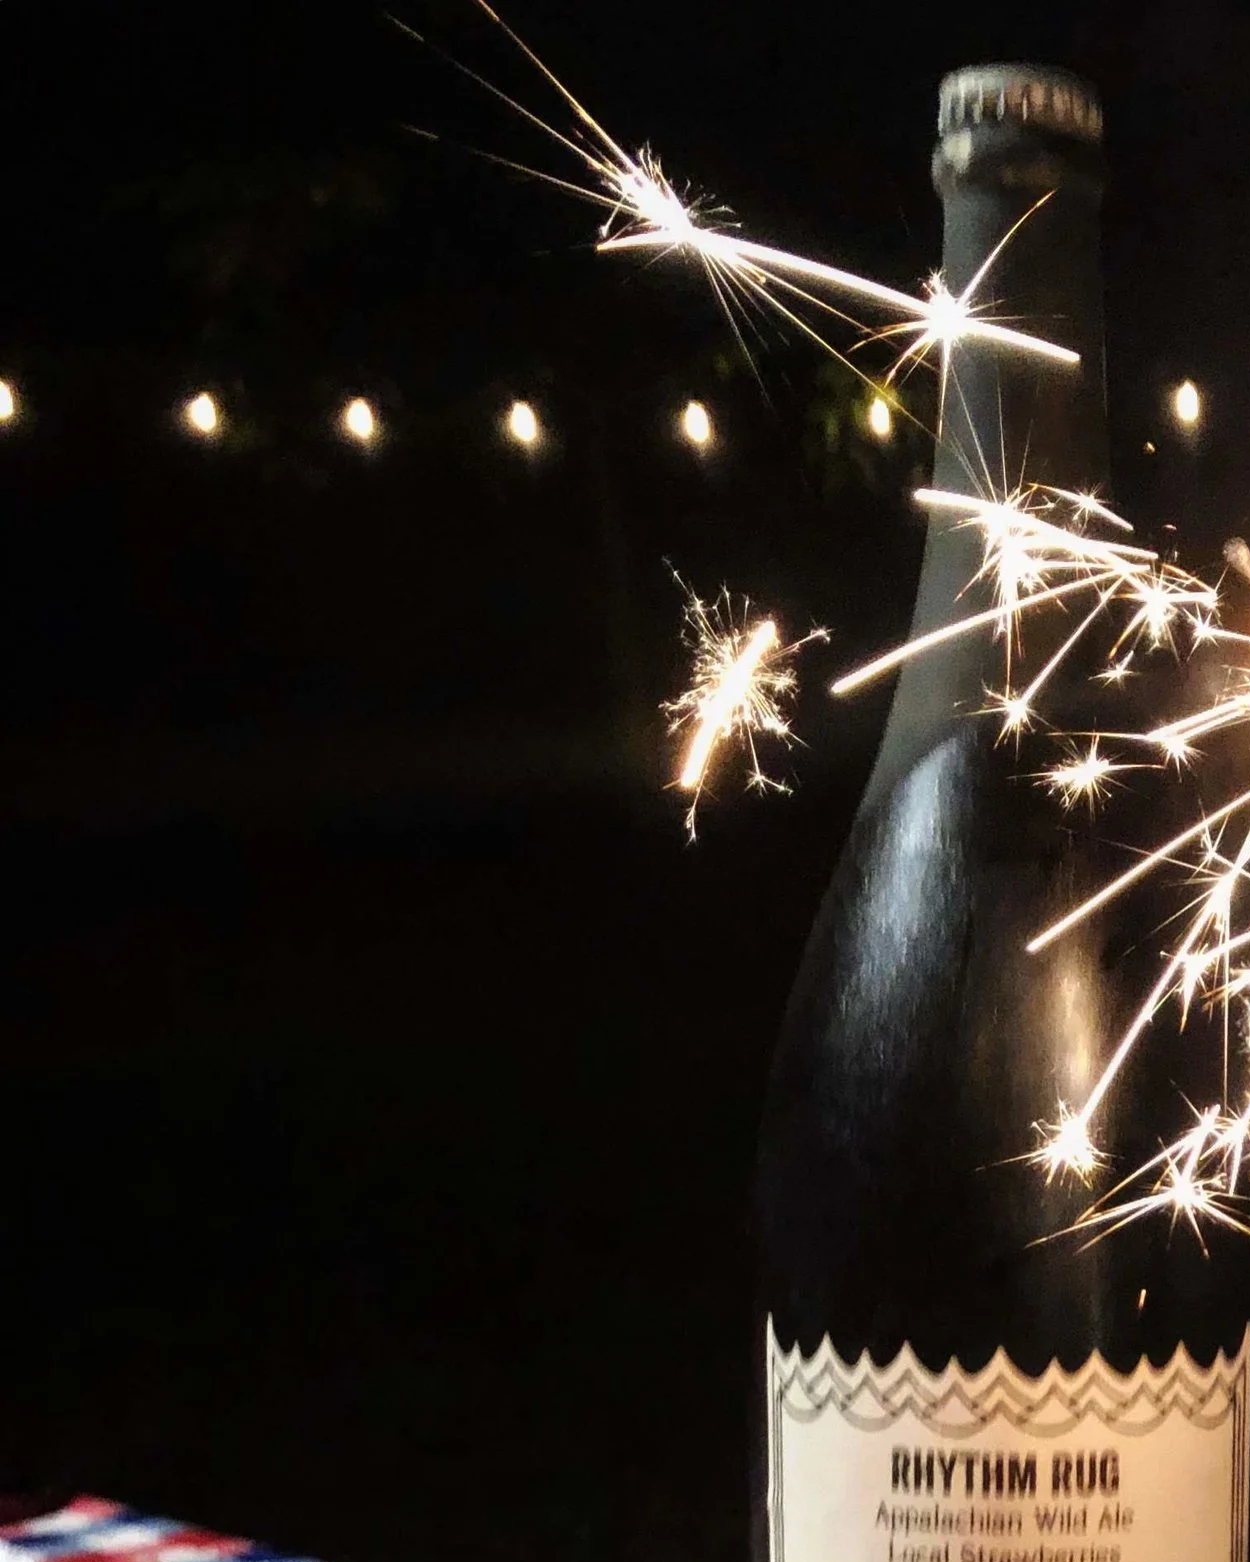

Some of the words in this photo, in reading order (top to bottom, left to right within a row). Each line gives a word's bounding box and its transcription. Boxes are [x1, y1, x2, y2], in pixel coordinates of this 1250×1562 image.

[891, 1443, 1037, 1499] RHYTHM
[1051, 1446, 1120, 1499] RUG
[874, 1500, 1023, 1538] Appalachian
[1035, 1503, 1088, 1537] Wild
[1098, 1502, 1135, 1534] Ale
